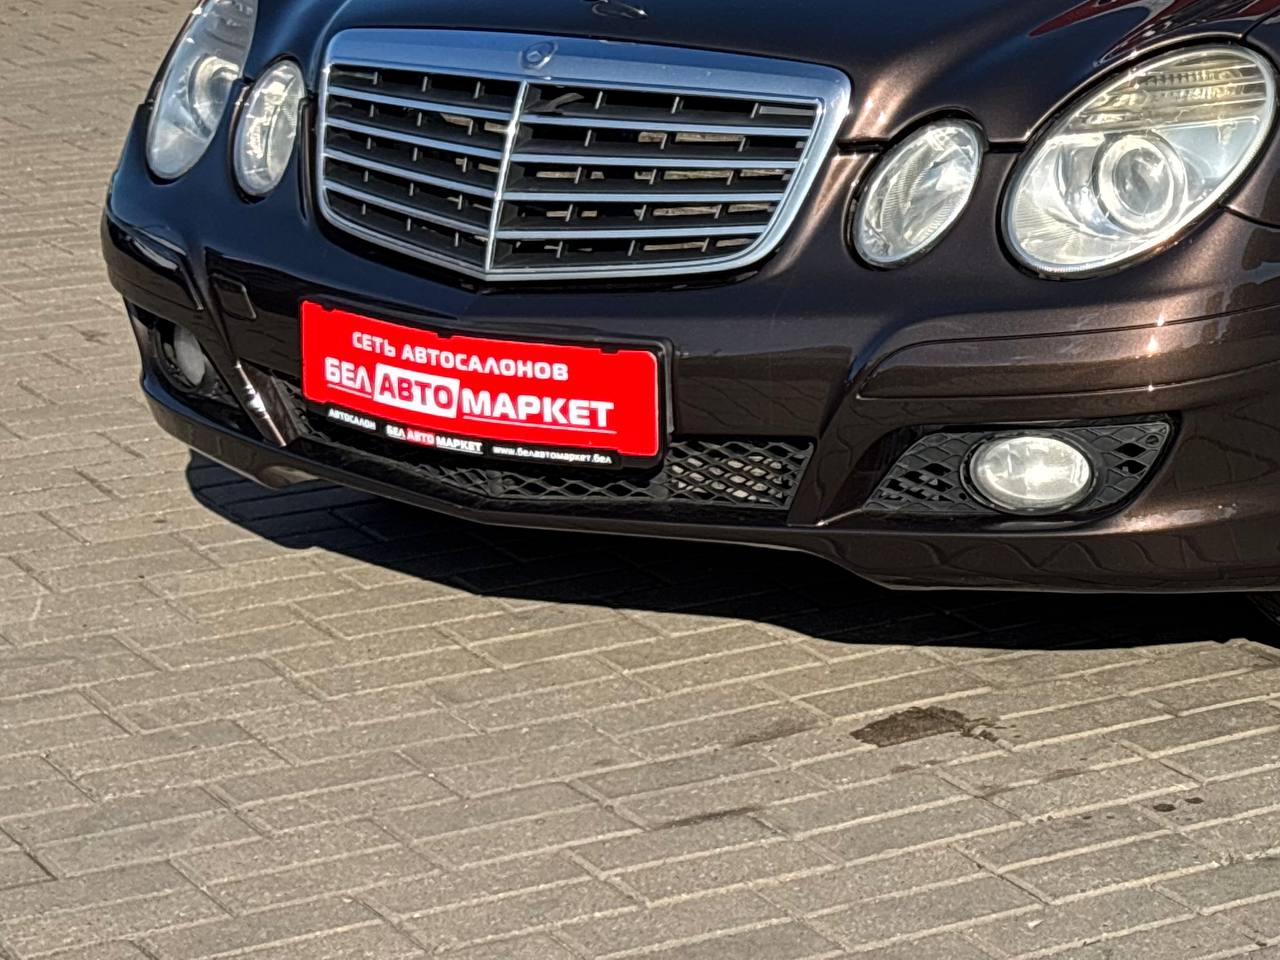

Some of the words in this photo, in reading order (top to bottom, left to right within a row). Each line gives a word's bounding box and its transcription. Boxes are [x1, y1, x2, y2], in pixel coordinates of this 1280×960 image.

[352, 331, 396, 357] СЕТЬ
[401, 344, 568, 381] АВТОСАЛОНОВ
[328, 408, 376, 430] АВТОСАЛОН
